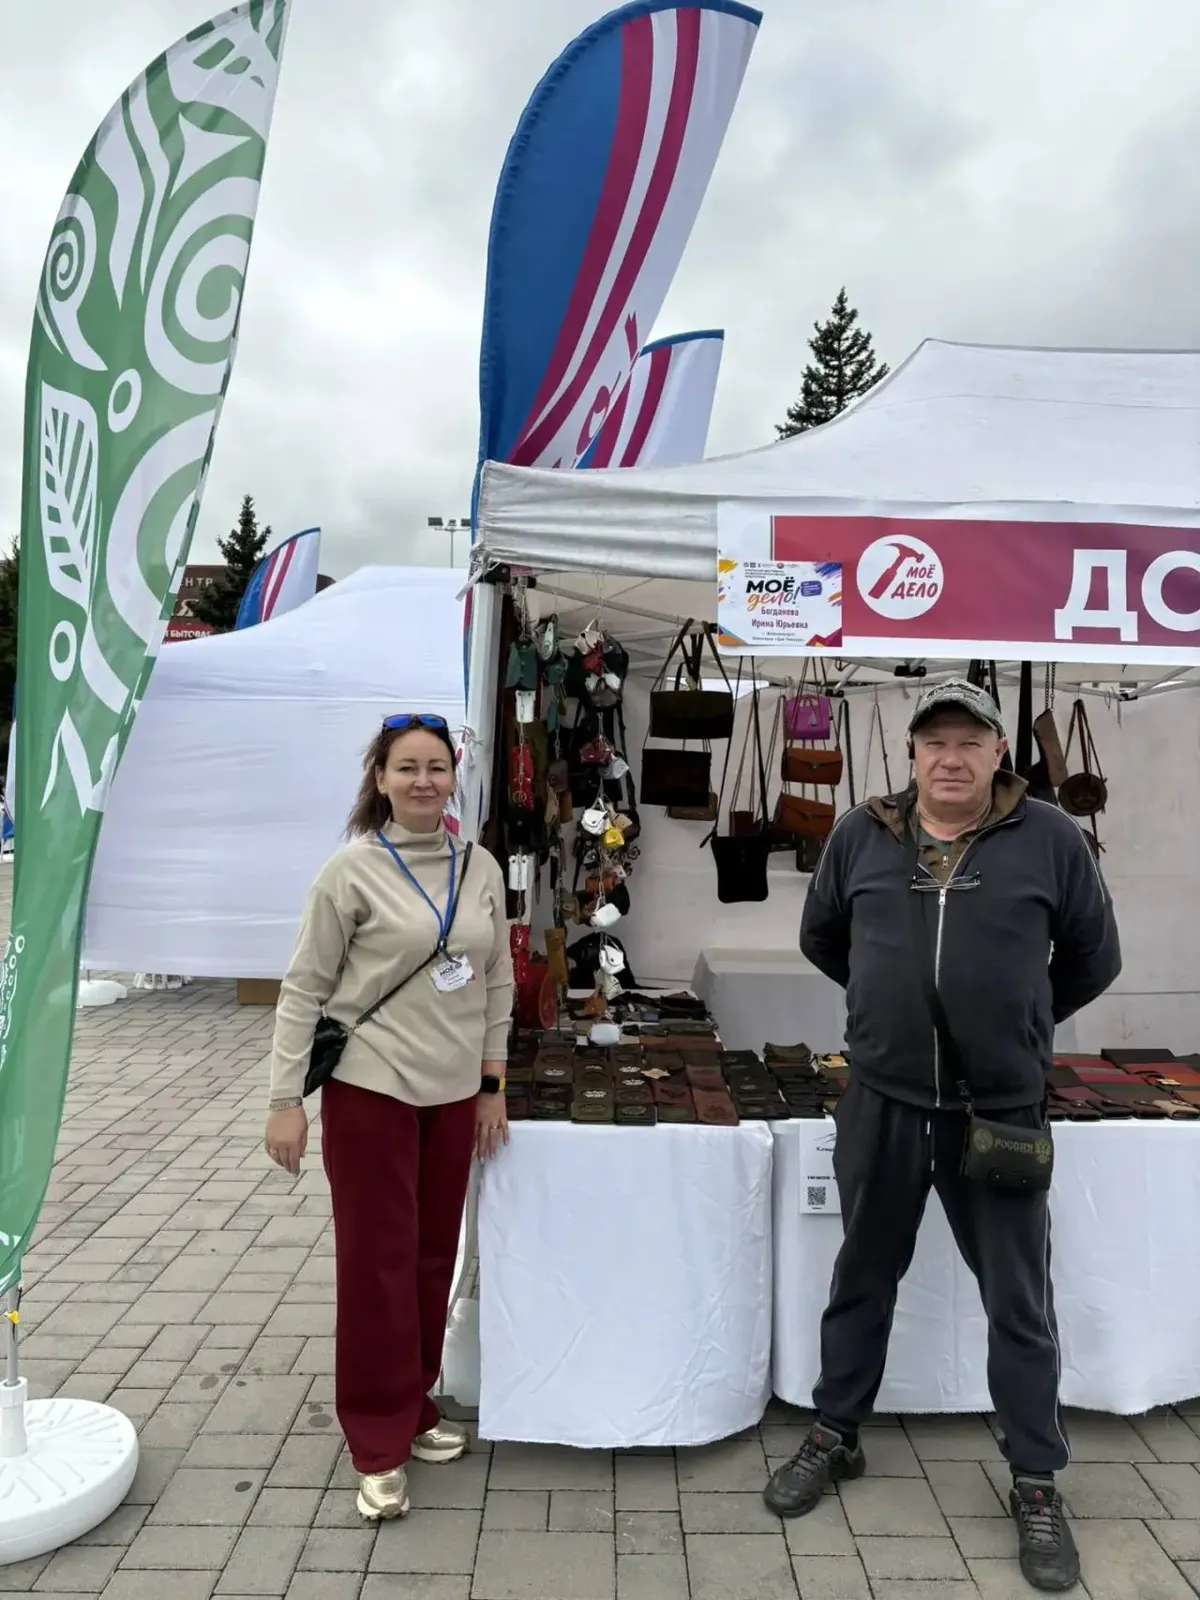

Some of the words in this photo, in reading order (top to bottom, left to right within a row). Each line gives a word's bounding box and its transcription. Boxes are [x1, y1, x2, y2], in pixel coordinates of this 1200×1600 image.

[906, 564, 936, 579] МОЁ
[180, 577, 213, 587] НТР
[746, 576, 795, 593] МОЁ
[890, 582, 938, 600] ДЕЛО
[761, 606, 799, 616] Богданова
[751, 619, 774, 629] Ирина
[776, 619, 809, 629] Юрьевна
